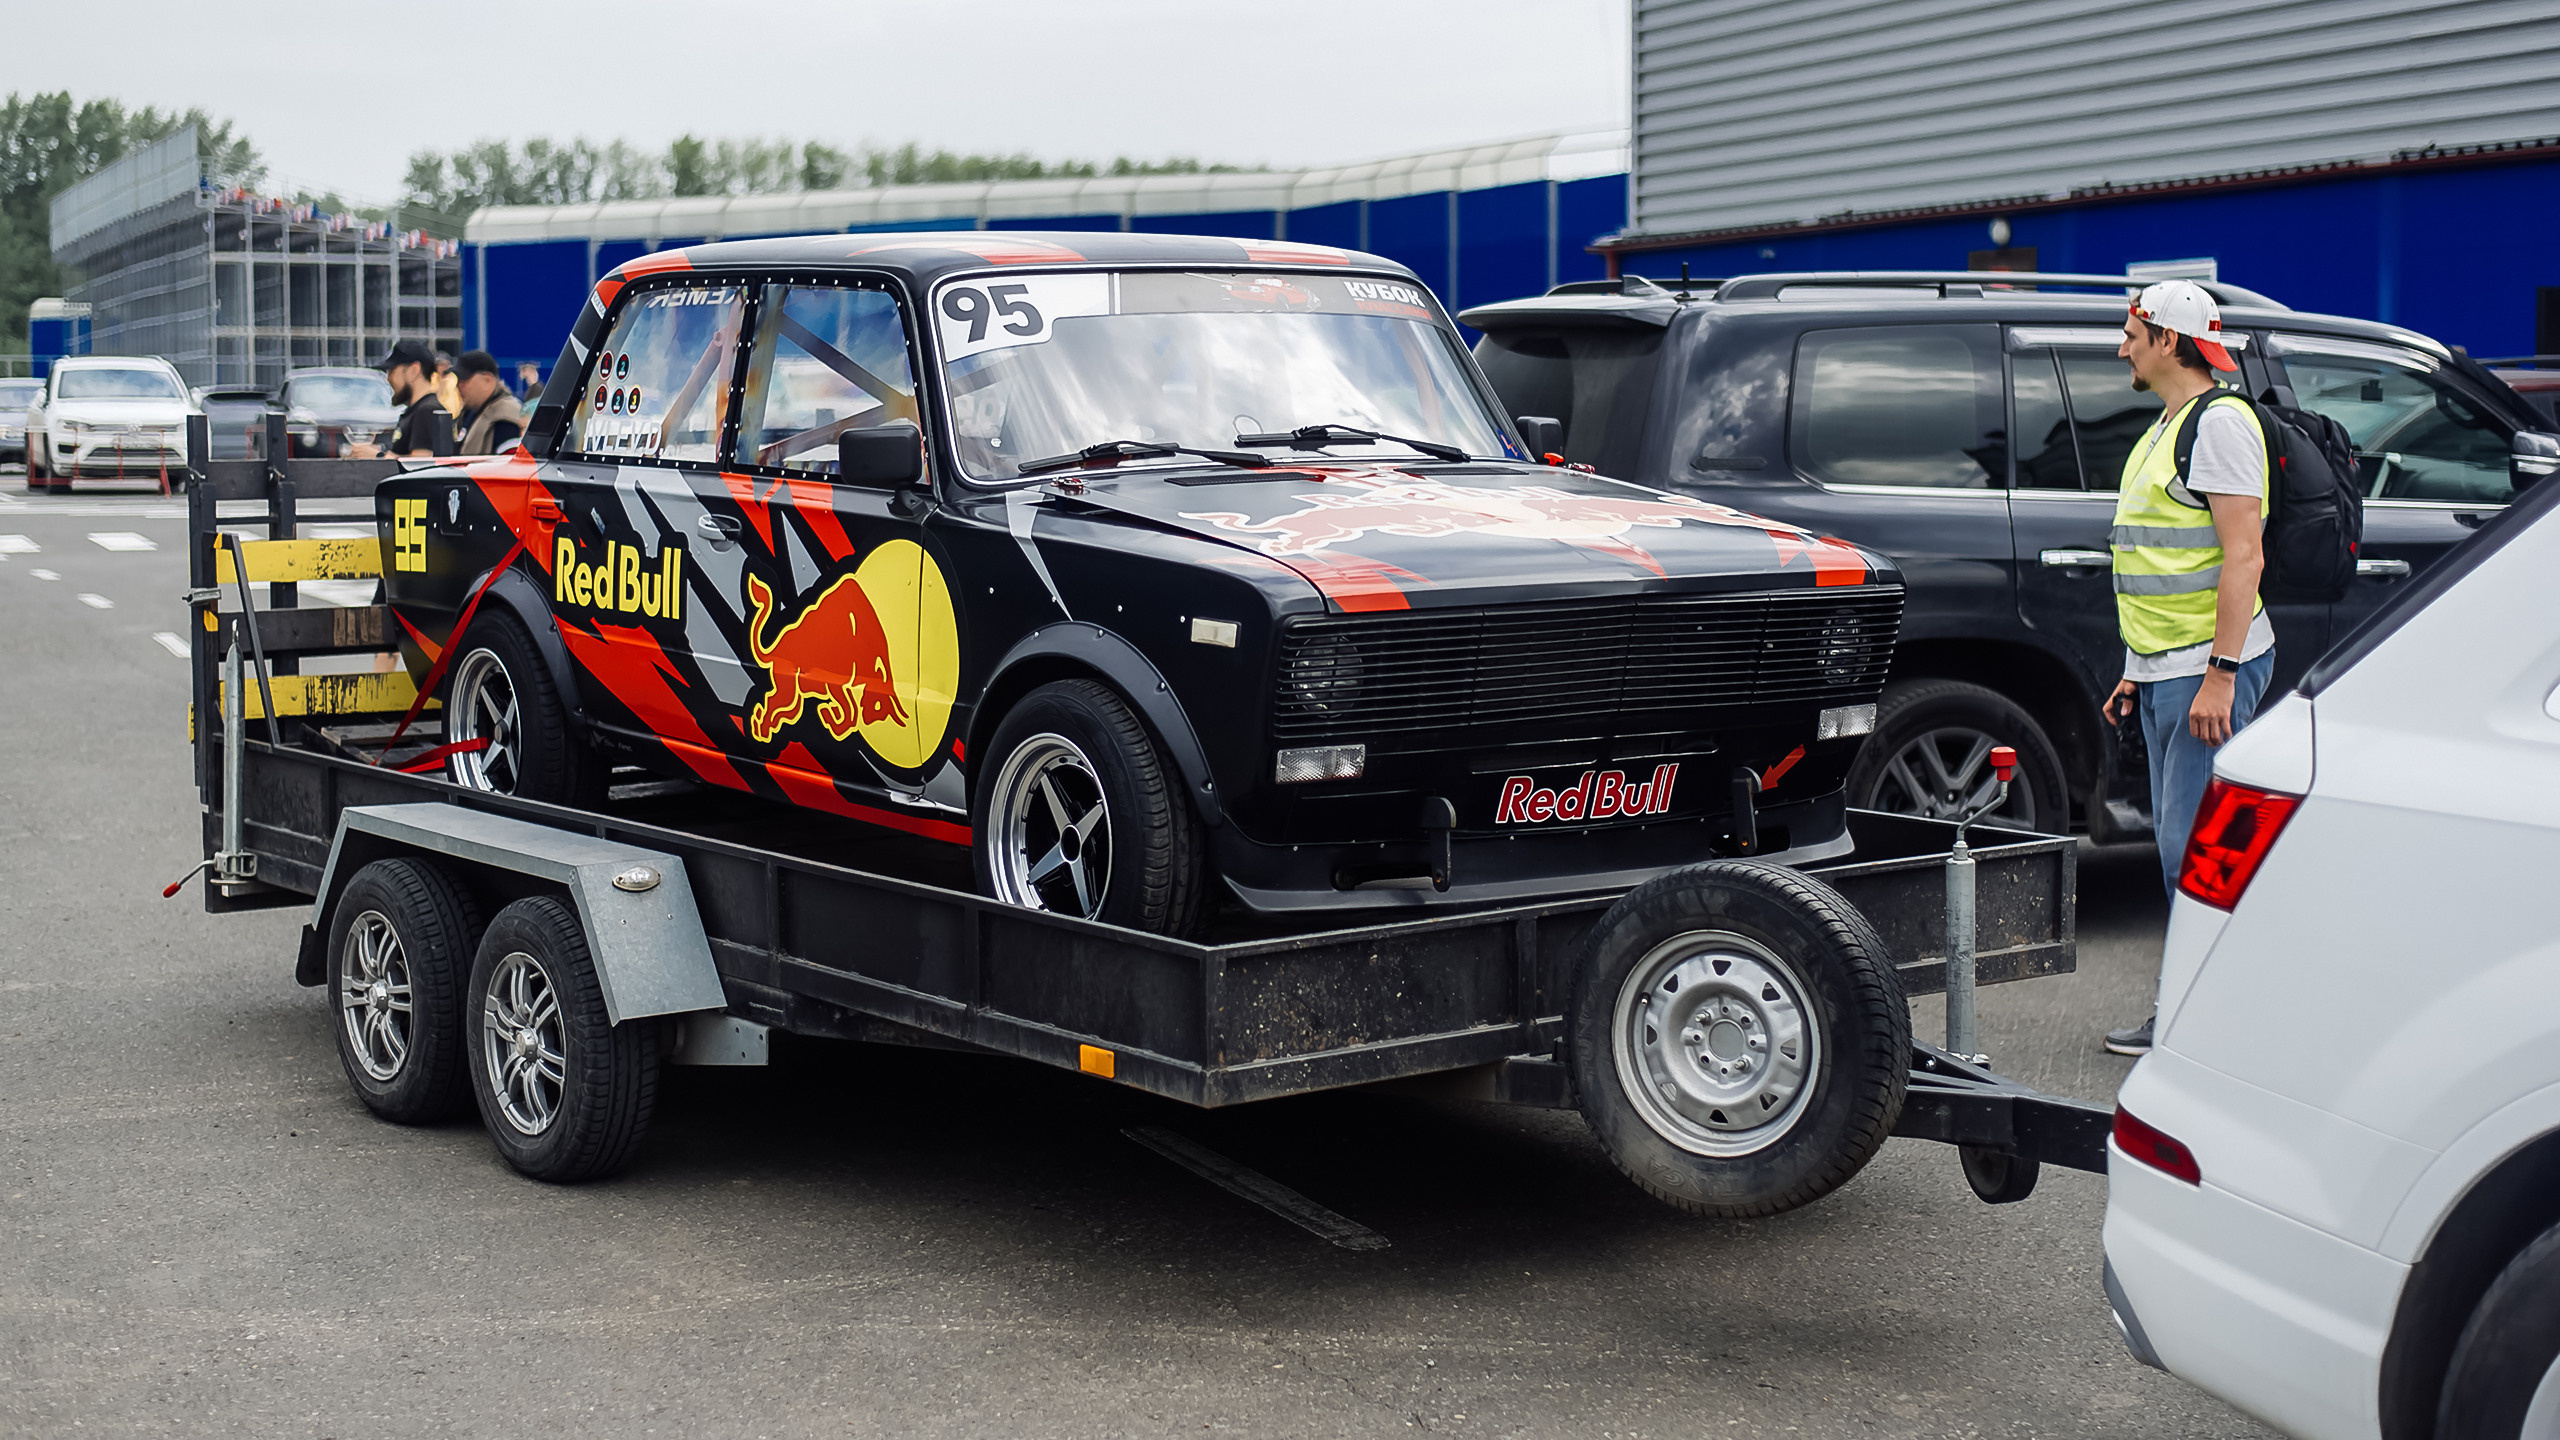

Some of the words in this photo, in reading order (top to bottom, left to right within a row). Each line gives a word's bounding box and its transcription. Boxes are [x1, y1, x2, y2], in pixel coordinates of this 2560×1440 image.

[942, 284, 1043, 343] 95
[1344, 281, 1426, 308] КУБОК
[394, 498, 428, 573] 95
[556, 536, 616, 610] Red
[618, 544, 682, 620] Bull
[1495, 770, 1596, 824] Red
[1590, 763, 1680, 819] Bull
